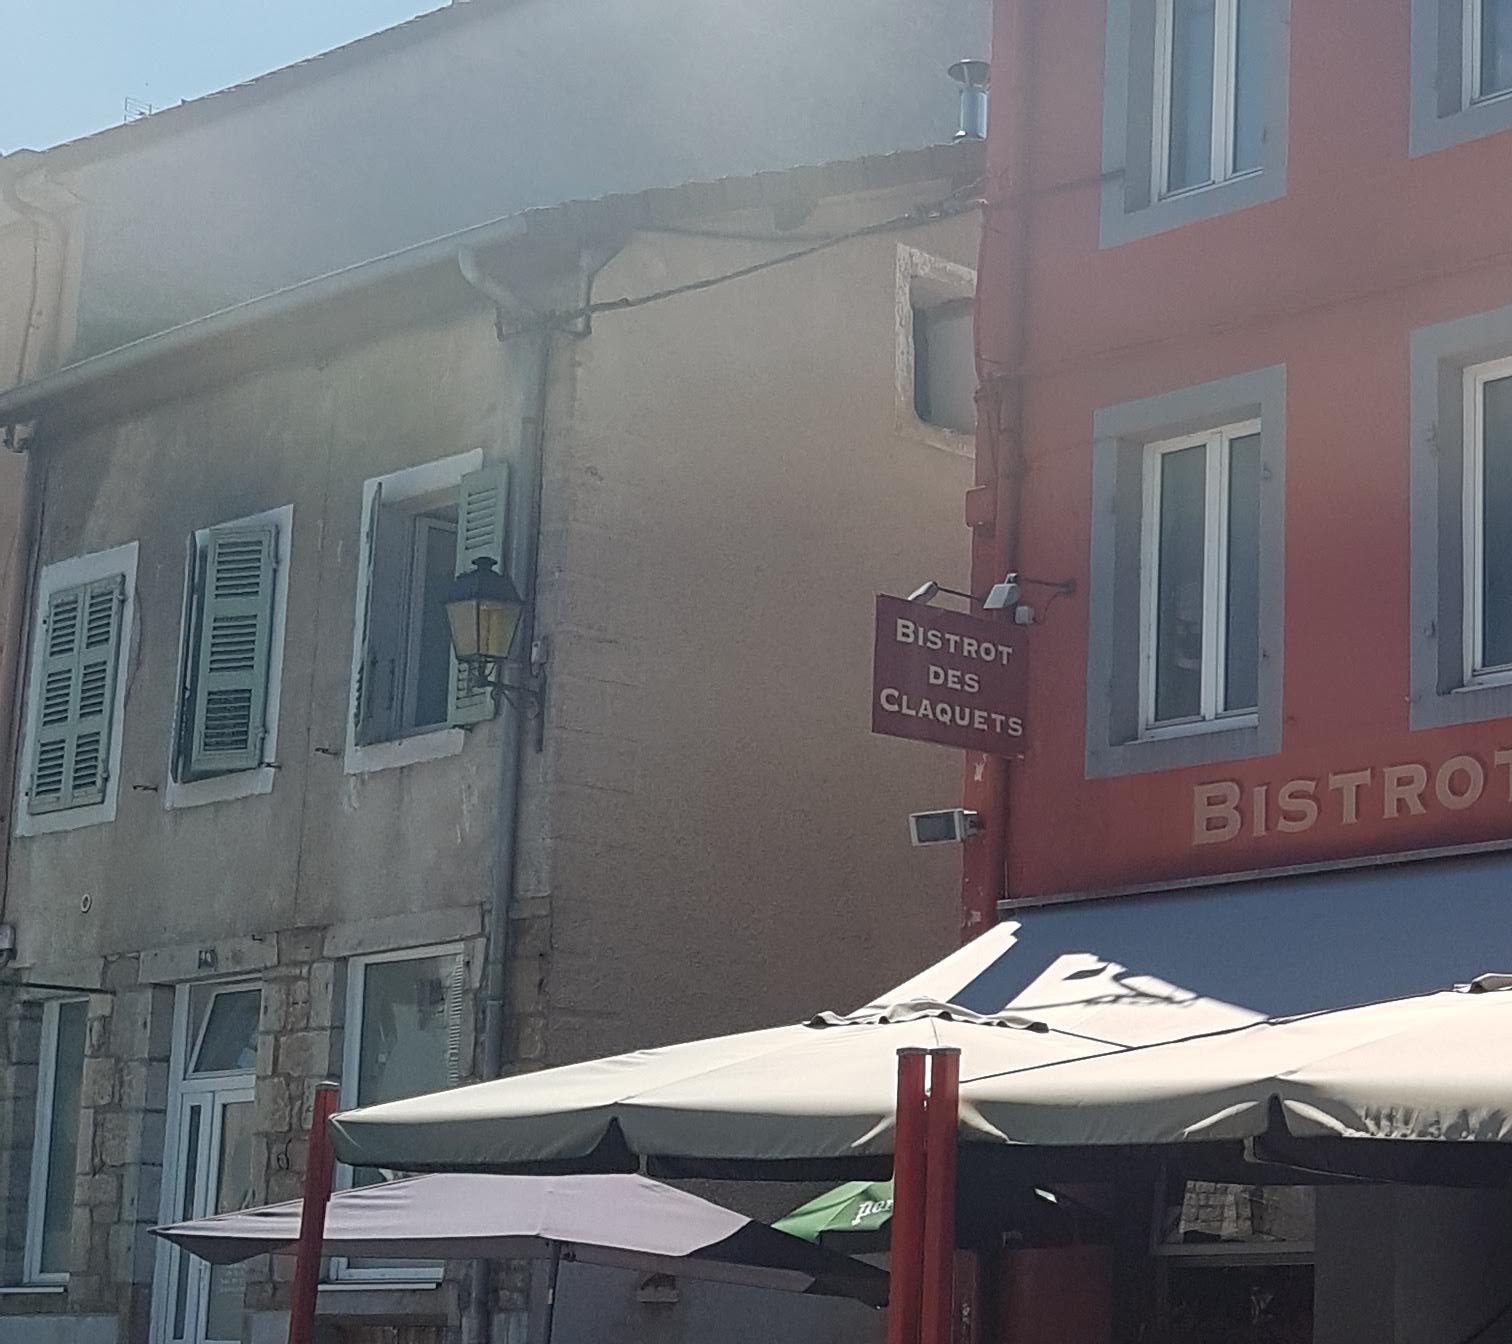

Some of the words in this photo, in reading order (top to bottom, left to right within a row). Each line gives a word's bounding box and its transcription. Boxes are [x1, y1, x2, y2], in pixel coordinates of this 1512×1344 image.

[895, 617, 1013, 665] BISTROT
[928, 664, 981, 693] DES
[879, 687, 1024, 738] CLAQUETS
